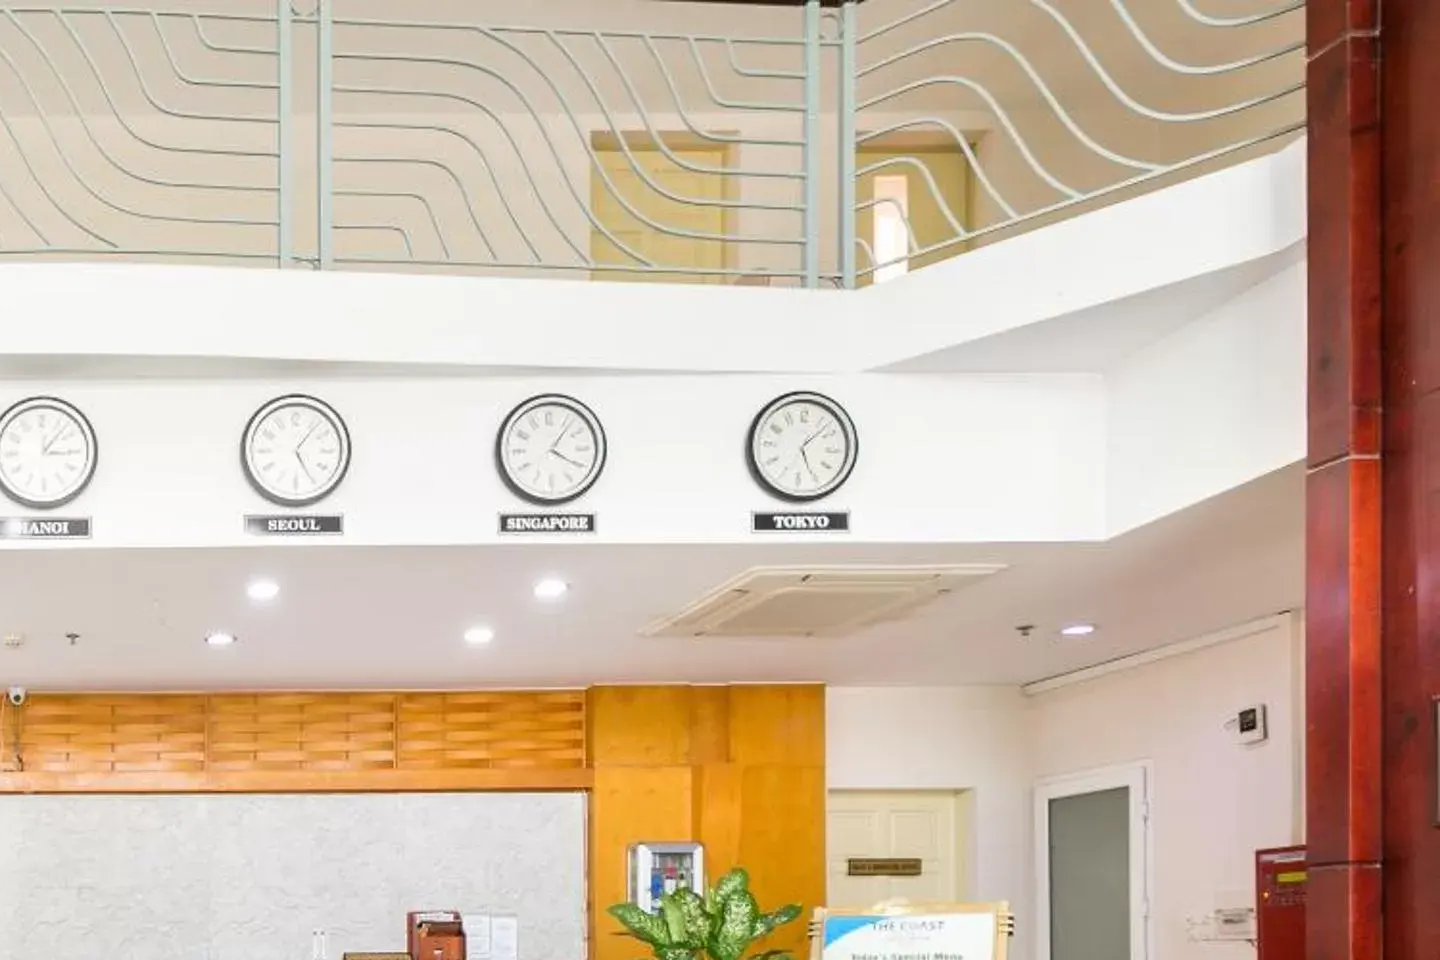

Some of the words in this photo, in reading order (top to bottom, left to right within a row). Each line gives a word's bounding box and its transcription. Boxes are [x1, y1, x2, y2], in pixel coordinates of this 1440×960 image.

[267, 518, 321, 532] SEOUL
[506, 516, 589, 530] SINGAPORE
[772, 515, 830, 529] TOKYO
